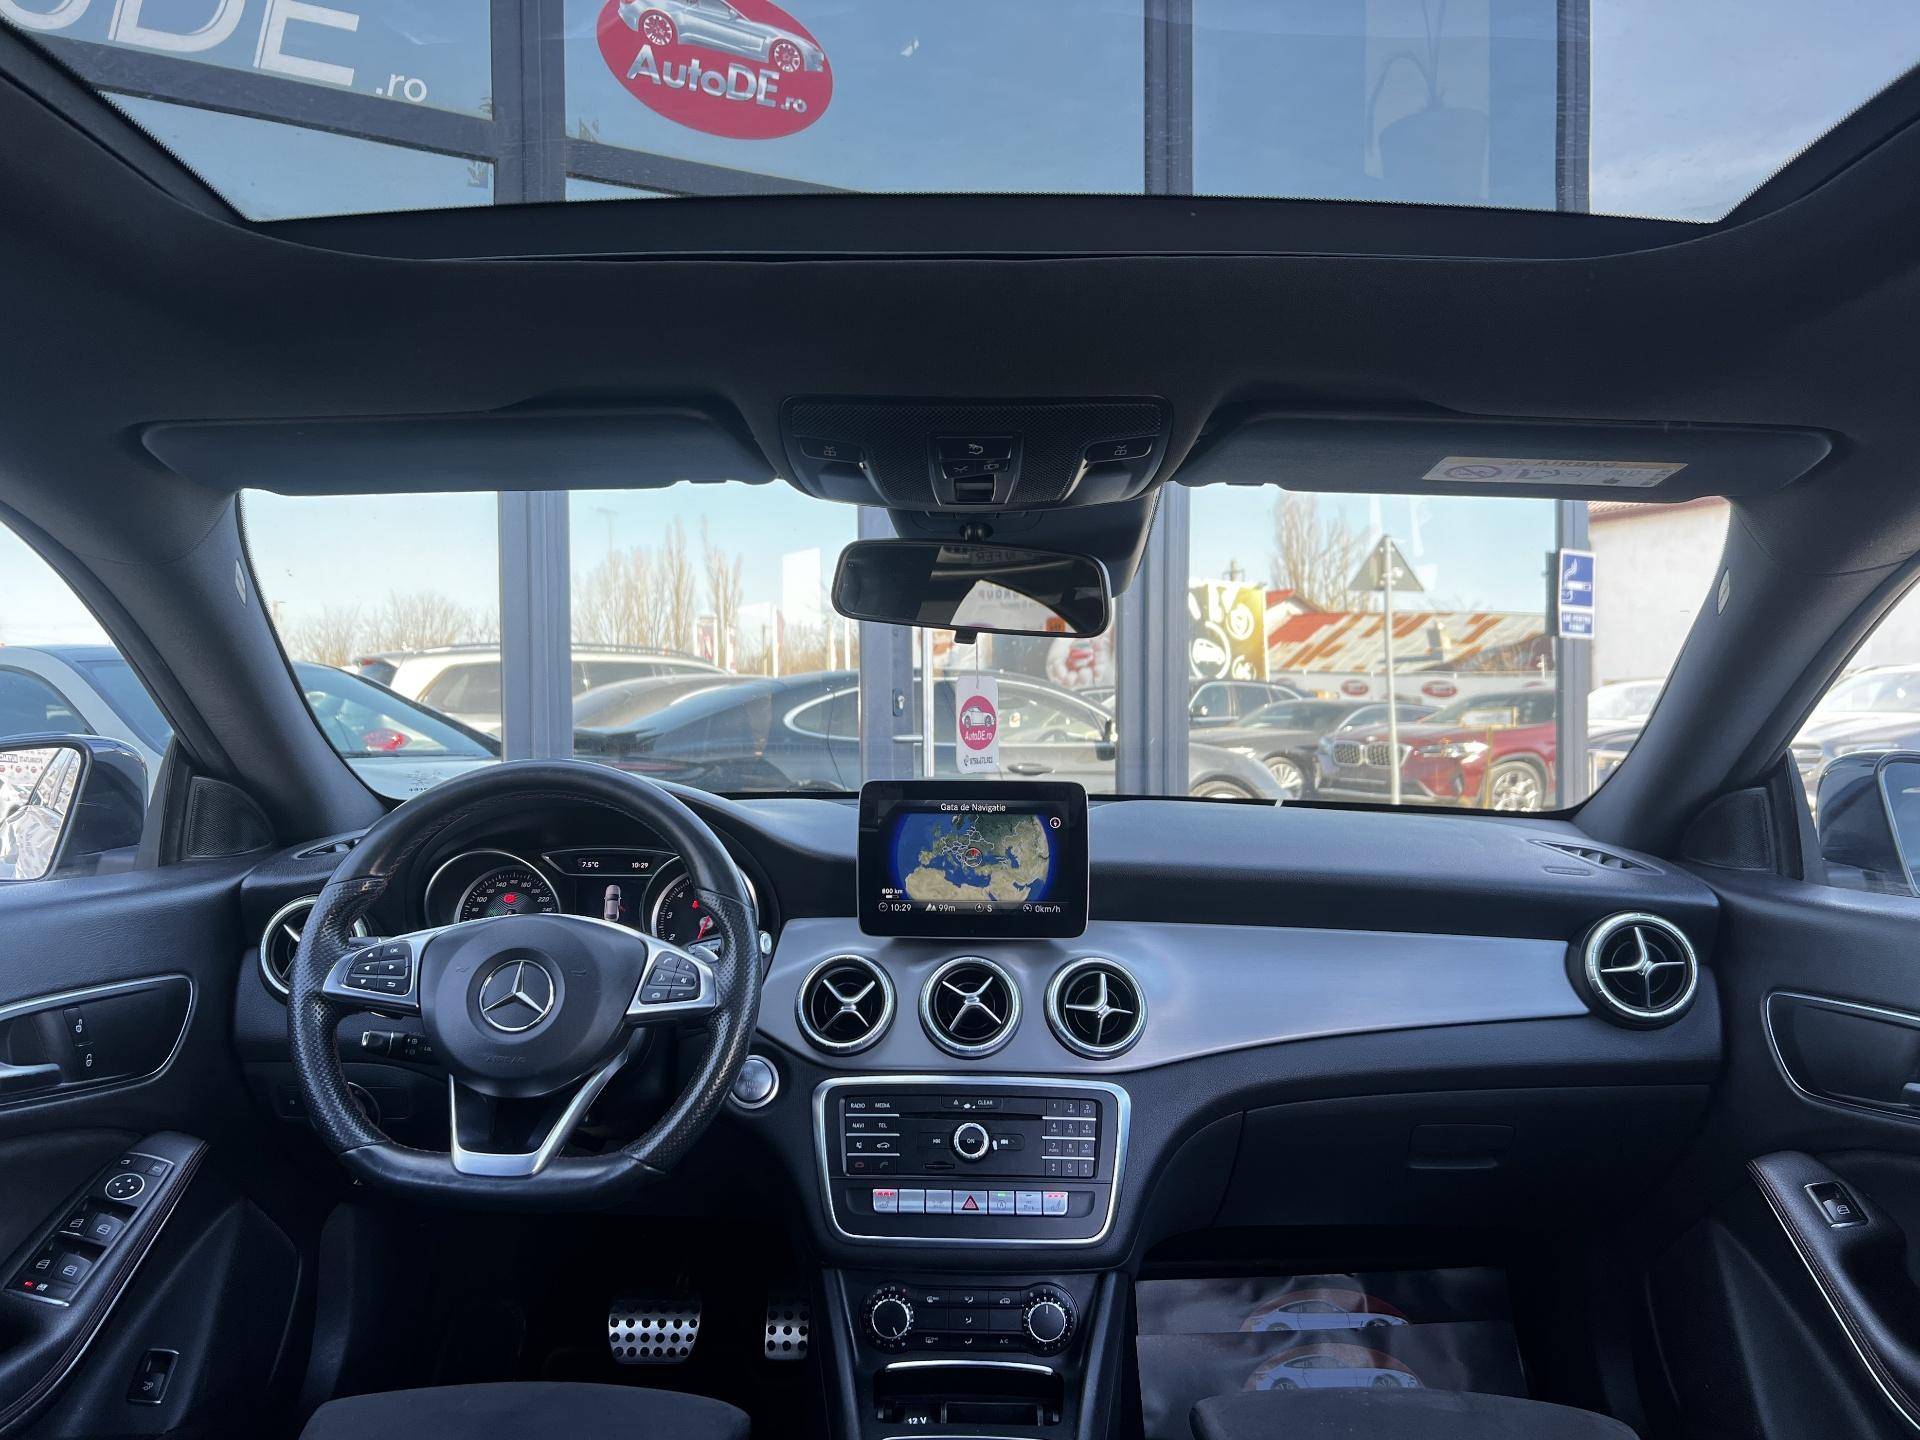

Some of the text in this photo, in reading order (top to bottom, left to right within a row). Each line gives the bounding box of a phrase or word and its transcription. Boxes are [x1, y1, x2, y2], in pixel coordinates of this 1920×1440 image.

[627, 44, 807, 113] AutoDE.ro
[965, 730, 993, 741] AutoDE.ro
[940, 803, 1006, 813] Gata de Navigatie
[890, 904, 912, 912] 10:29
[938, 904, 956, 912] 99m
[987, 905, 993, 913] S
[1034, 904, 1061, 913] 0km/h
[666, 911, 673, 919] 3
[668, 933, 676, 941] 2
[907, 1416, 927, 1425] 12 V
